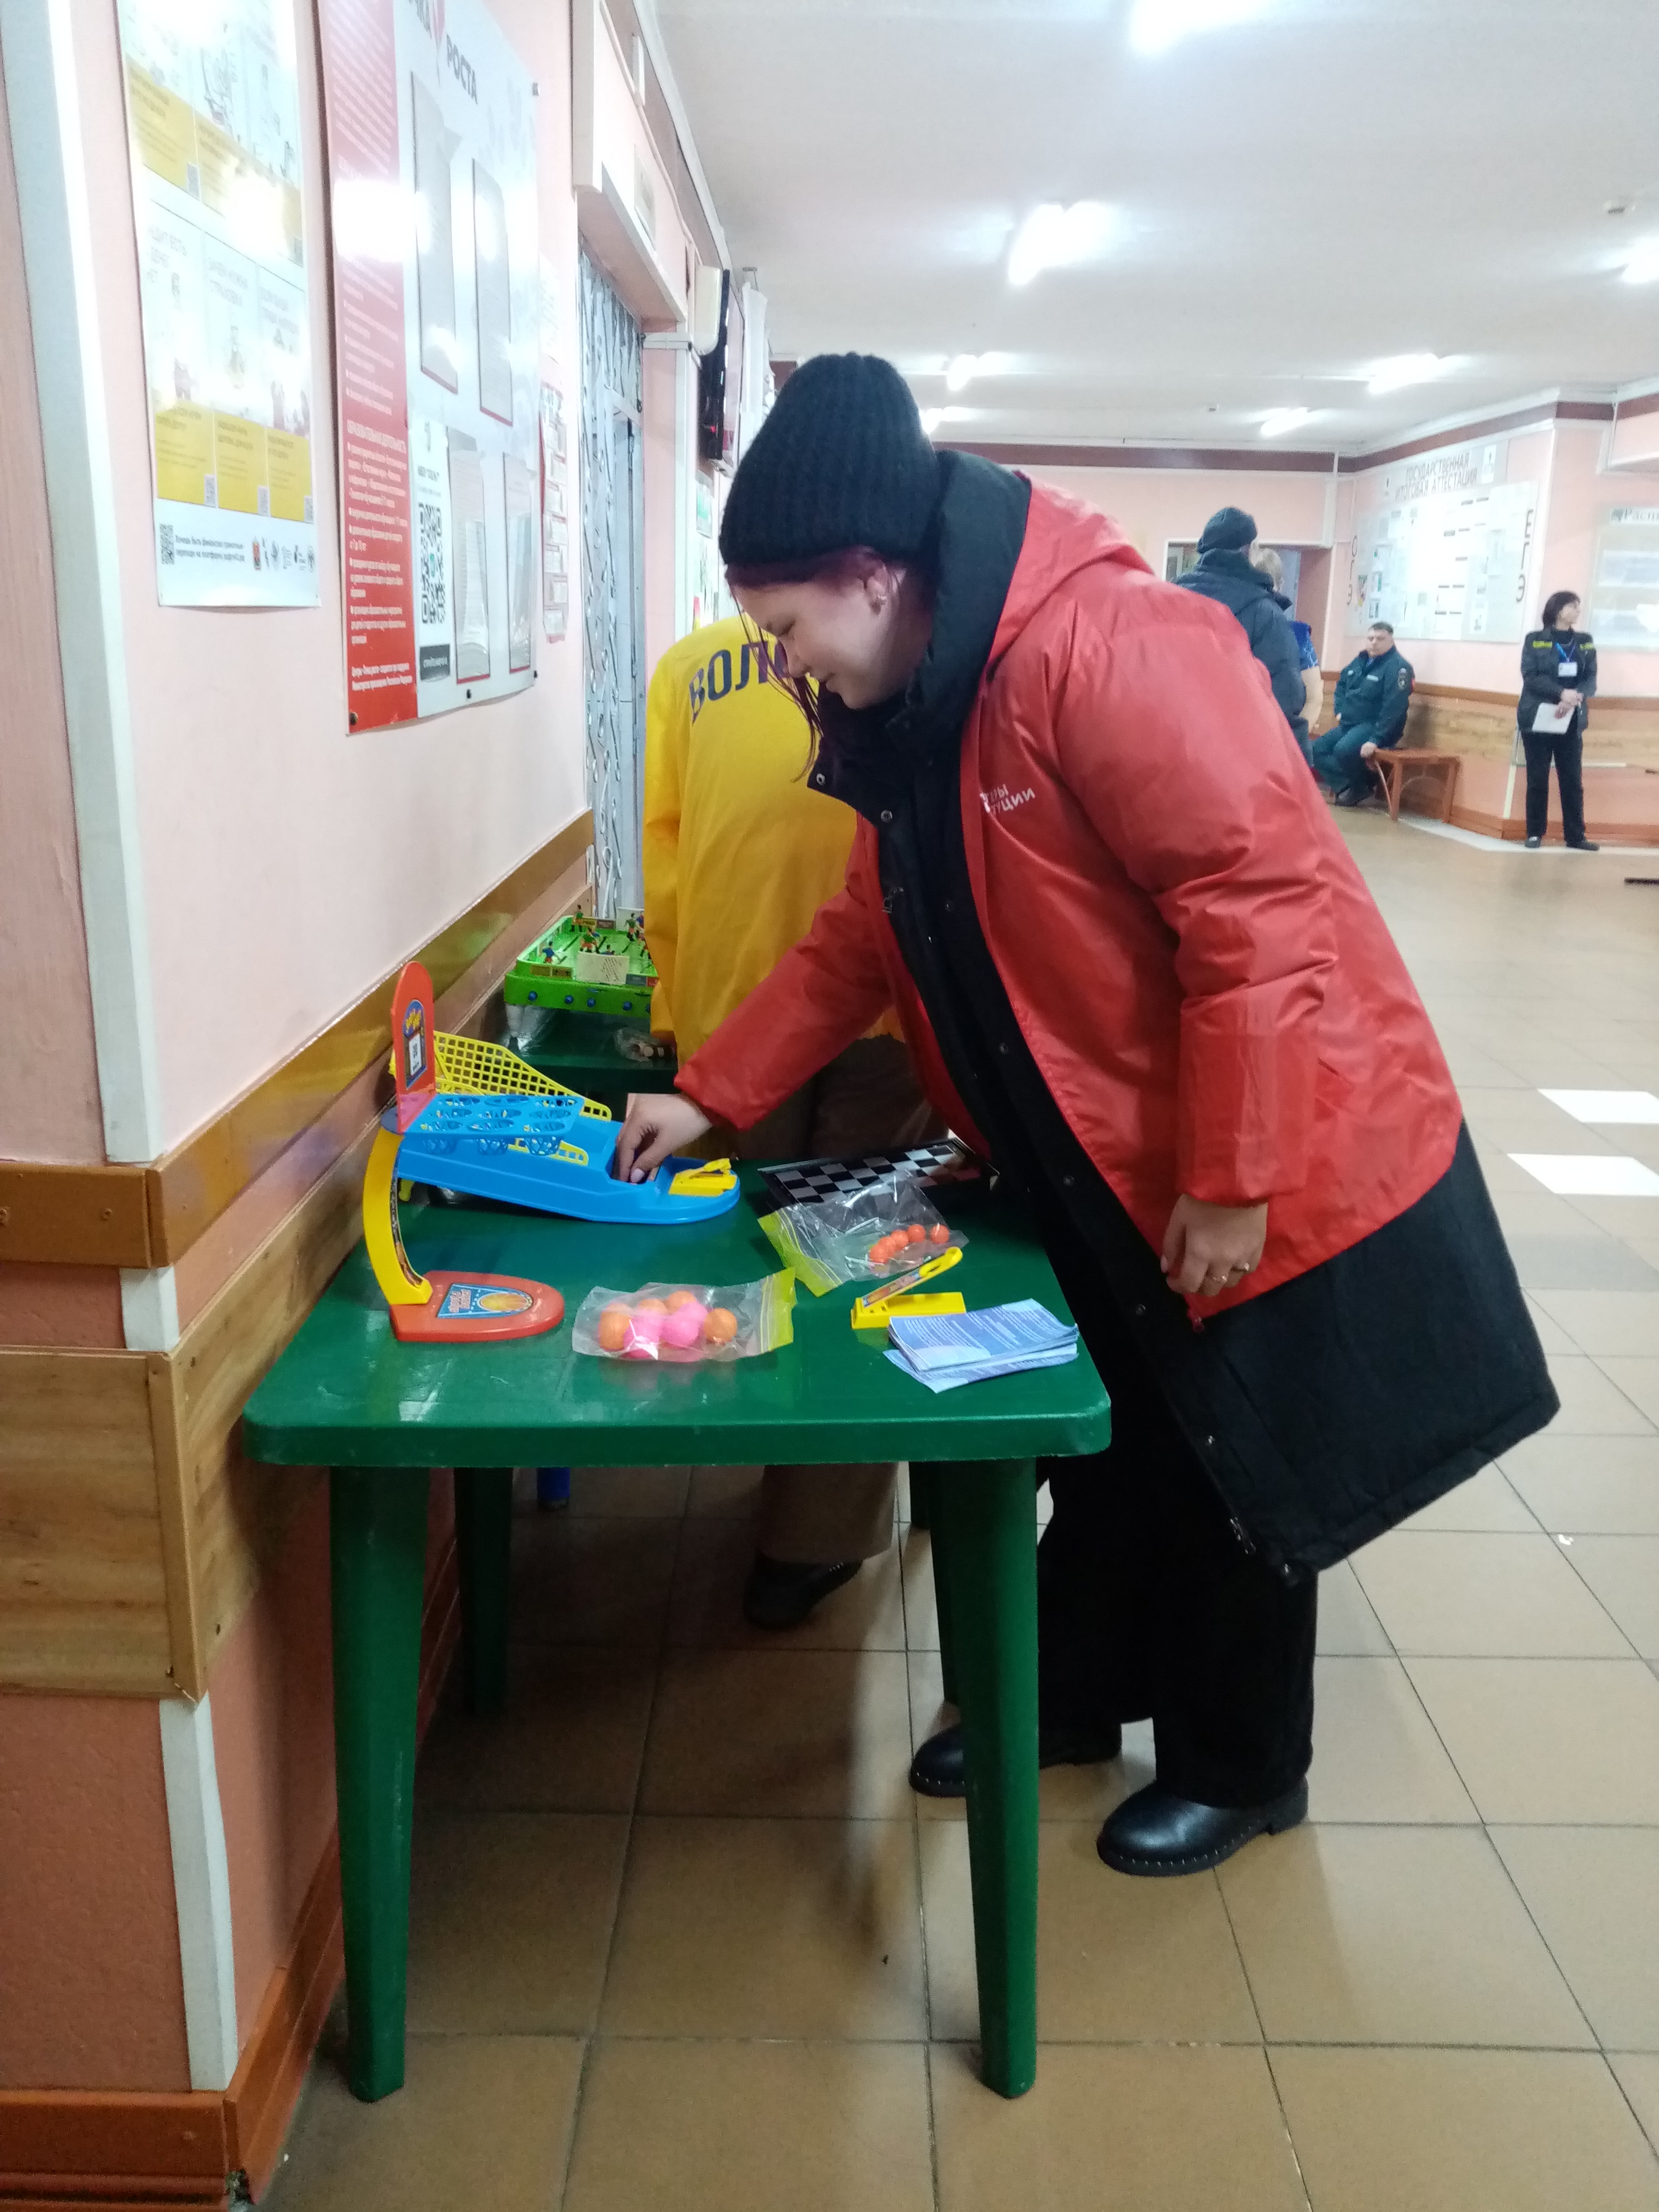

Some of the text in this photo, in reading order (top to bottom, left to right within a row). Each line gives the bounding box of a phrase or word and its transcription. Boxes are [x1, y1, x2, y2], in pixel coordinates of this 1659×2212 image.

[446, 33, 478, 105] РОСТА
[1395, 467, 1477, 502] ИТОГОВАЯ АТТЕСТАЦИЯ
[1405, 452, 1470, 484] ГОСУДАРСТВЕННАЯ
[1347, 535, 1358, 605] ОГЭ
[1516, 508, 1534, 603] ЕГЭ
